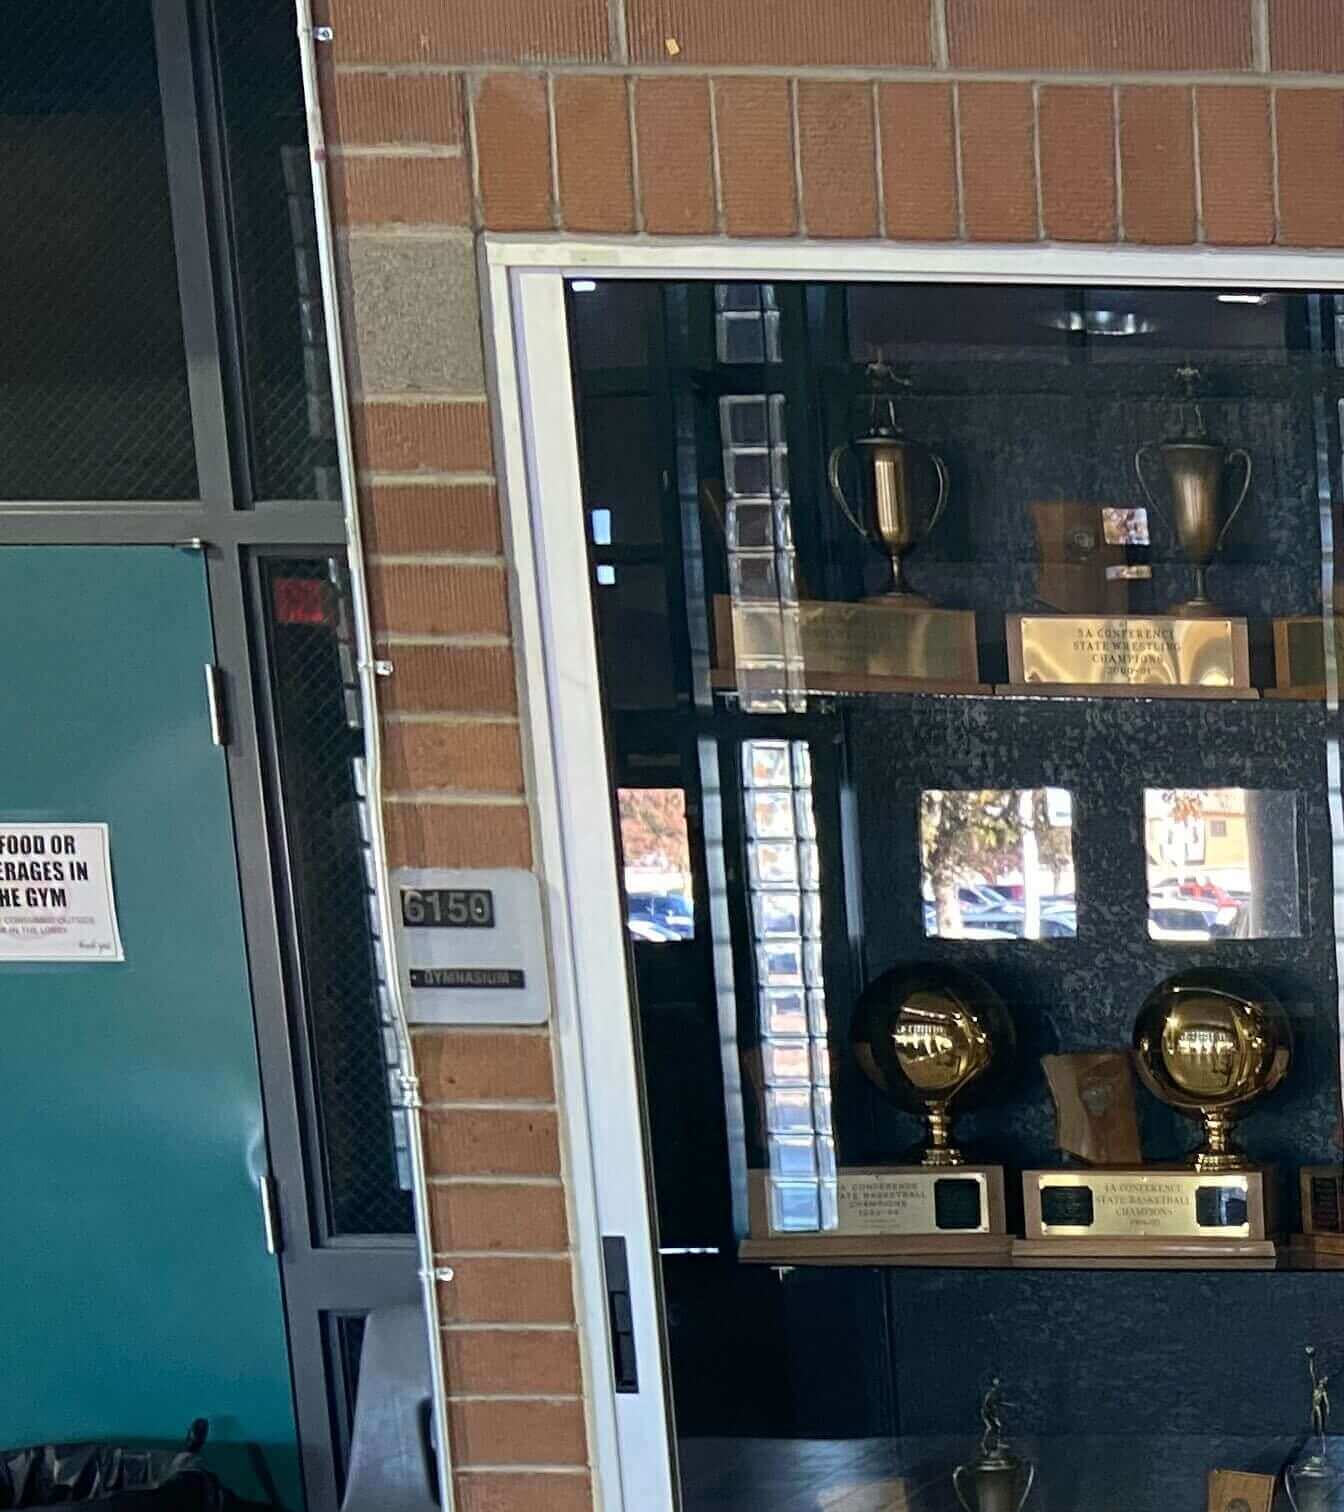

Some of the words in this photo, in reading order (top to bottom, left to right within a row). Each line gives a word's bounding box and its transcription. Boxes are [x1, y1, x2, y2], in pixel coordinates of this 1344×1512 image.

[51, 835, 76, 855] OR
[69, 861, 89, 881] IN
[26, 887, 67, 908] GYM
[404, 891, 490, 922] 6150
[423, 969, 510, 985] GYMNASIUM
[1115, 1207, 1177, 1217] CHAMPIONS
